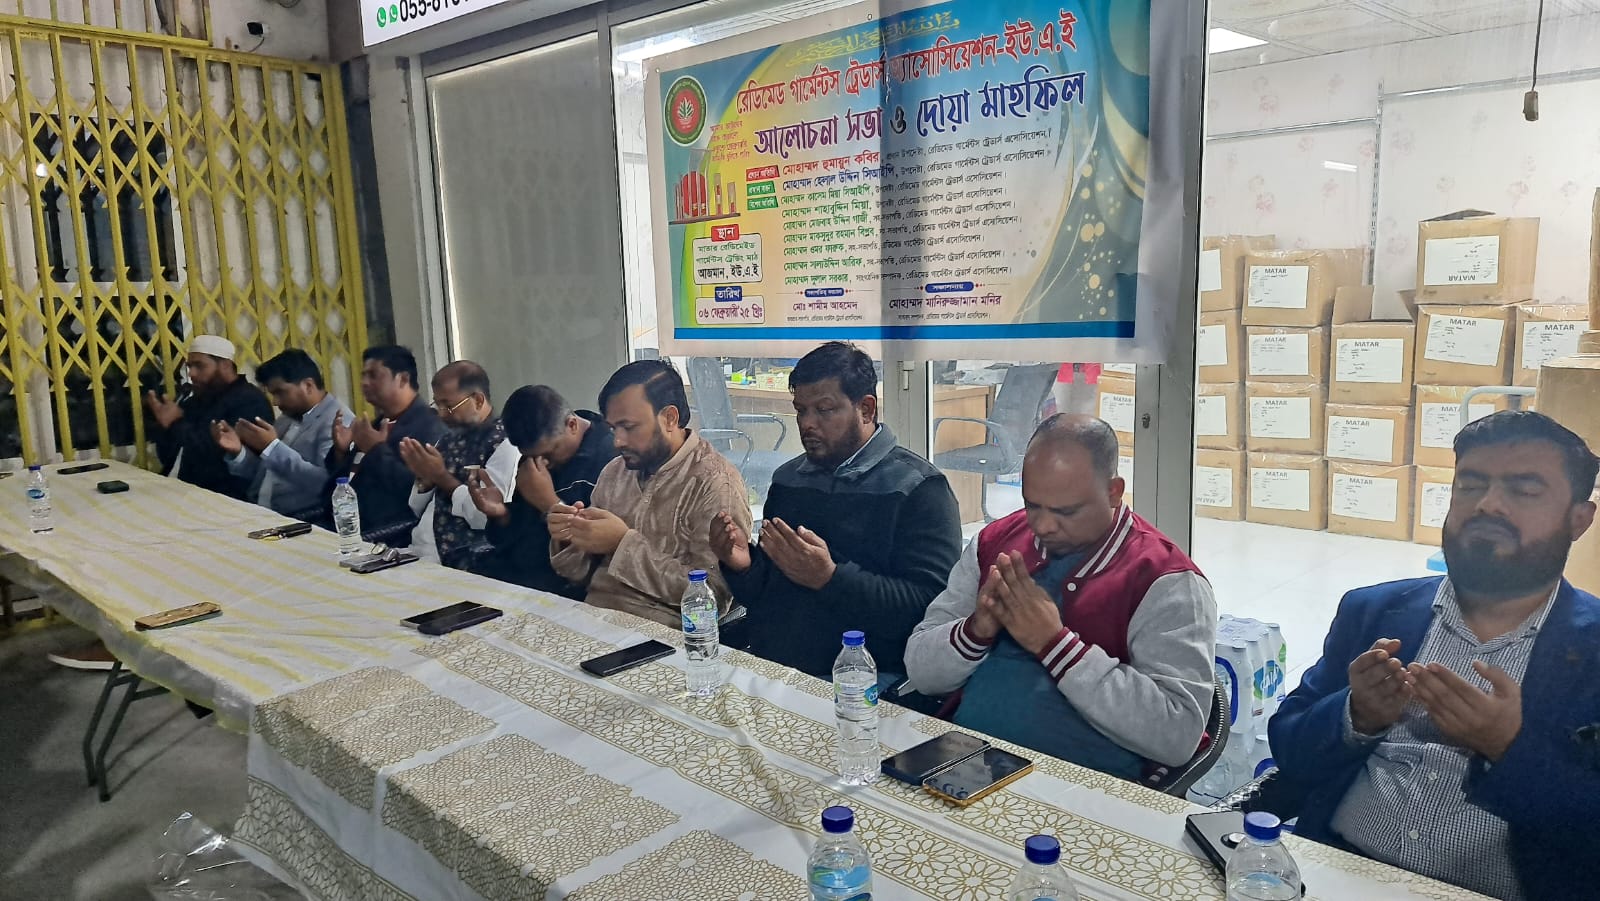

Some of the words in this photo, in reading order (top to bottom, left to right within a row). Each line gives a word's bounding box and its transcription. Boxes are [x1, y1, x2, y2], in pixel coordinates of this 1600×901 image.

[737, 79, 785, 114] রেডিমেড
[790, 63, 840, 103] গার্মেন্টস
[754, 115, 838, 159] আলোচনা
[847, 106, 883, 142] সভা
[890, 106, 907, 135] ও
[916, 89, 970, 137] দোয়া
[980, 65, 1086, 118] মাহফিল
[783, 161, 819, 175] মোহাম্মদ
[783, 178, 812, 191] মোহাম্মদ
[716, 227, 735, 240] স্থান
[715, 286, 741, 299] তারিখ
[889, 298, 923, 309] মোহাম্মদ
[980, 292, 1002, 306] মনির
[1449, 318, 1477, 327] MATAR
[1345, 419, 1370, 427] MATAR
